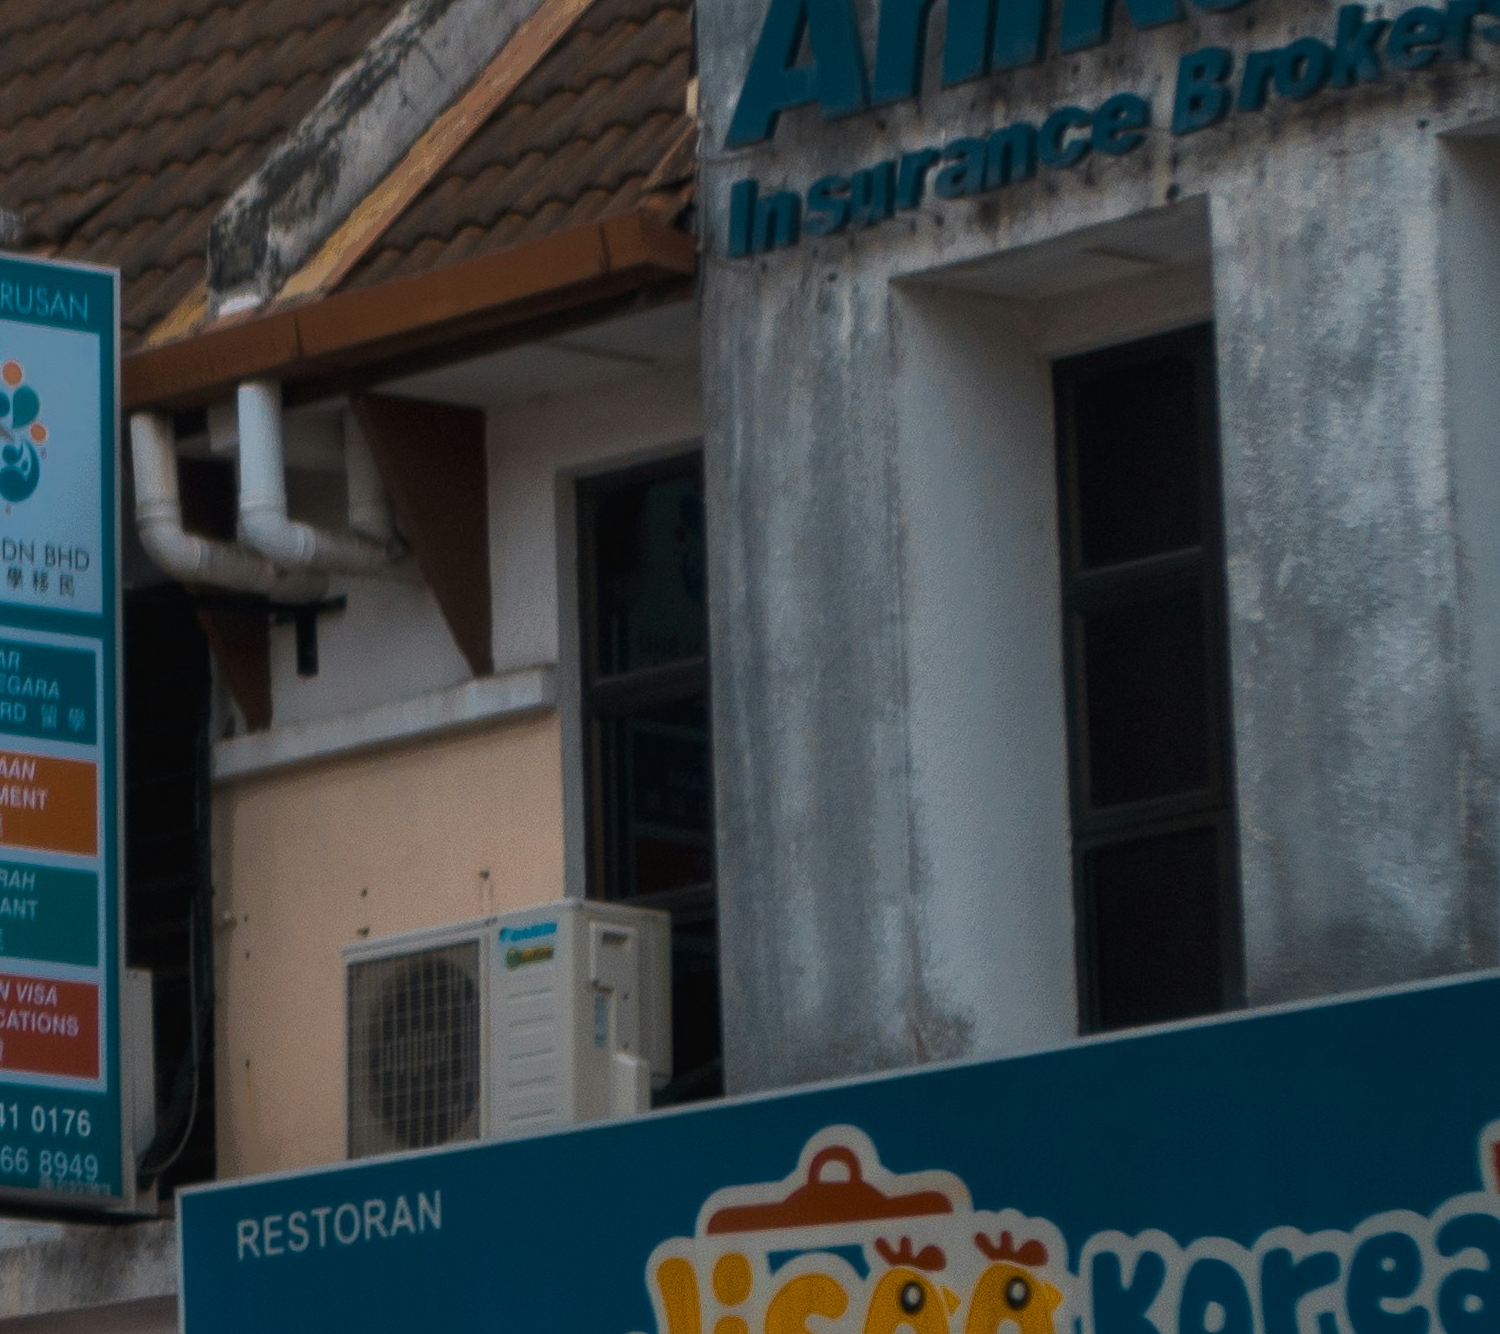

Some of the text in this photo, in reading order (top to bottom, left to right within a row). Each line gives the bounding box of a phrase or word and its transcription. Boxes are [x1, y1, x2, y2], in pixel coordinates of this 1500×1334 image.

[728, 92, 1154, 259] Insurance
[44, 542, 90, 572] BHD
[16, 981, 58, 1007] VISA
[31, 1104, 91, 1138] 0176
[39, 1149, 99, 1183] 8949
[237, 1190, 442, 1260] RESTORAN
